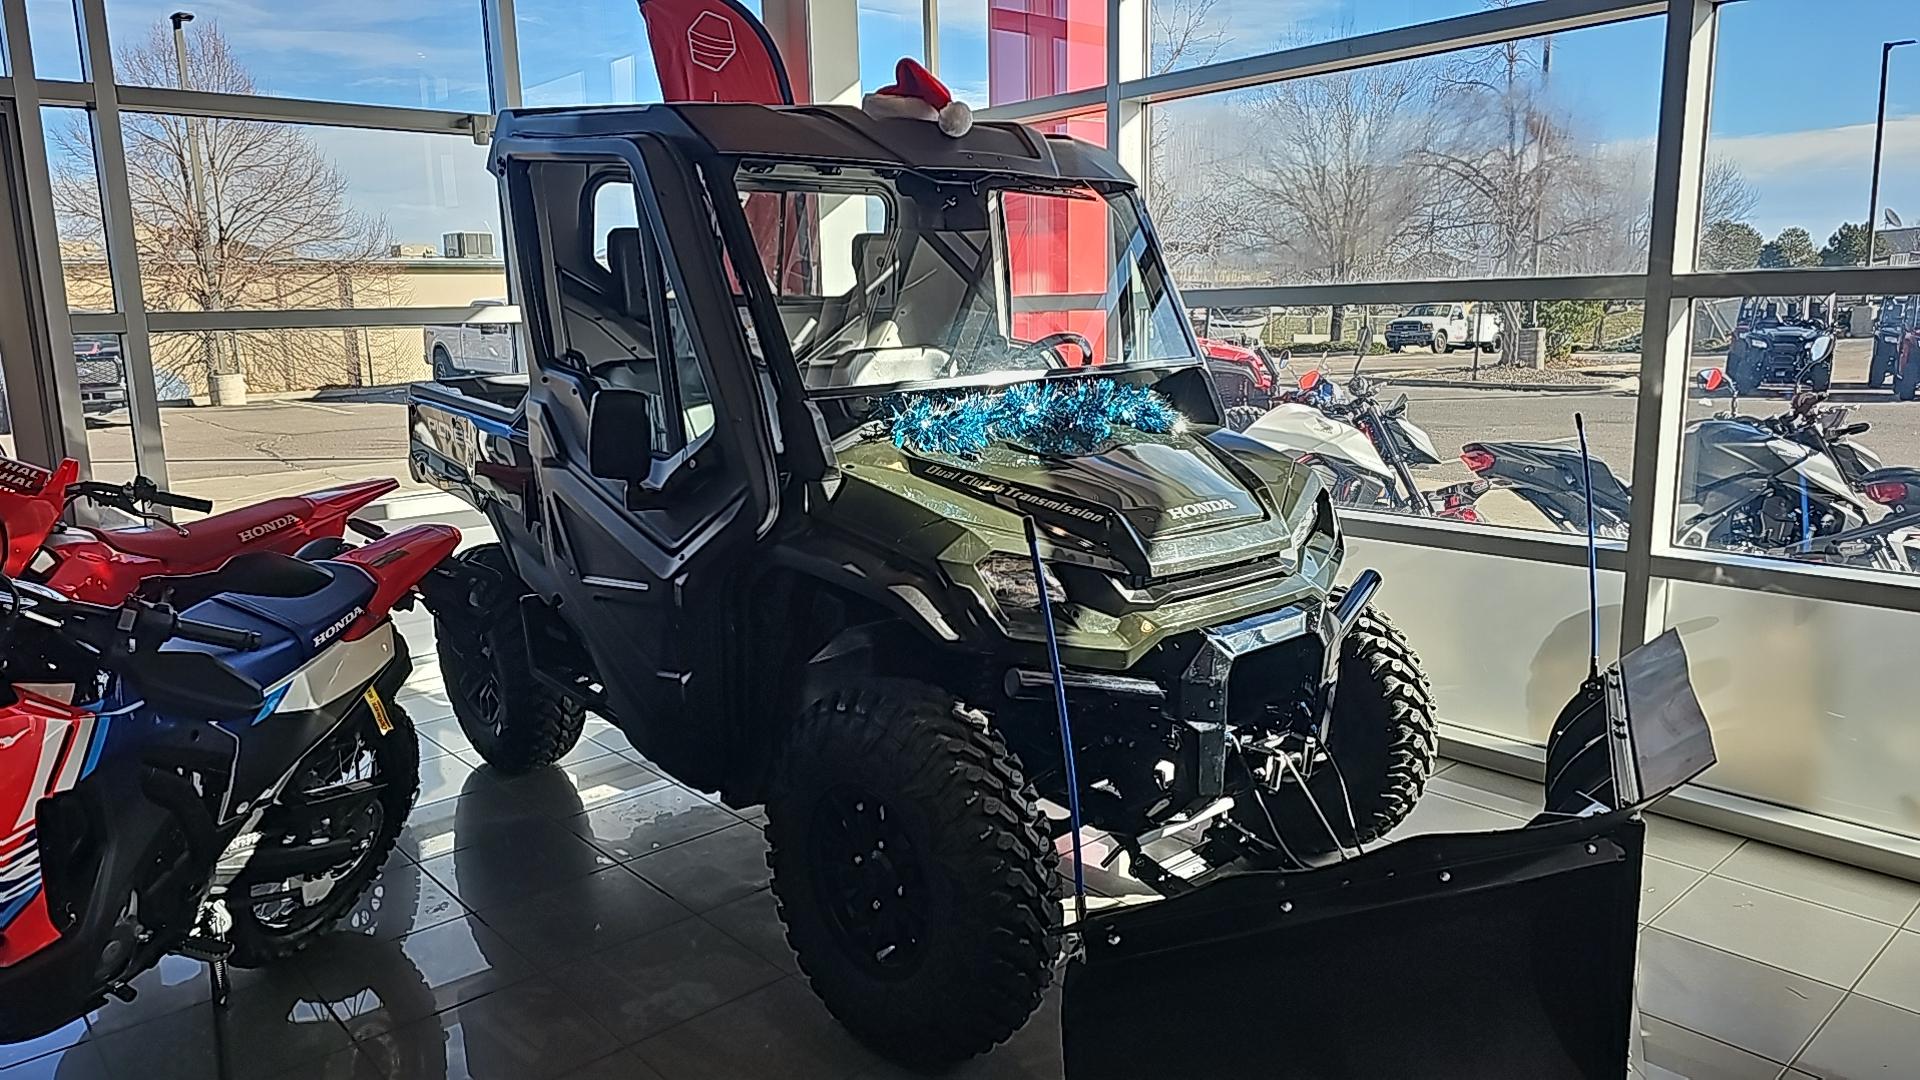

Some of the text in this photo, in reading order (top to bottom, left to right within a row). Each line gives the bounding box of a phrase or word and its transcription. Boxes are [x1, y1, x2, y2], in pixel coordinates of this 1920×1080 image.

[924, 464, 1105, 523] Dual Clutch Transmission
[1166, 499, 1237, 520] HONDA
[238, 514, 300, 542] HONDA
[312, 606, 365, 648] HONDA
